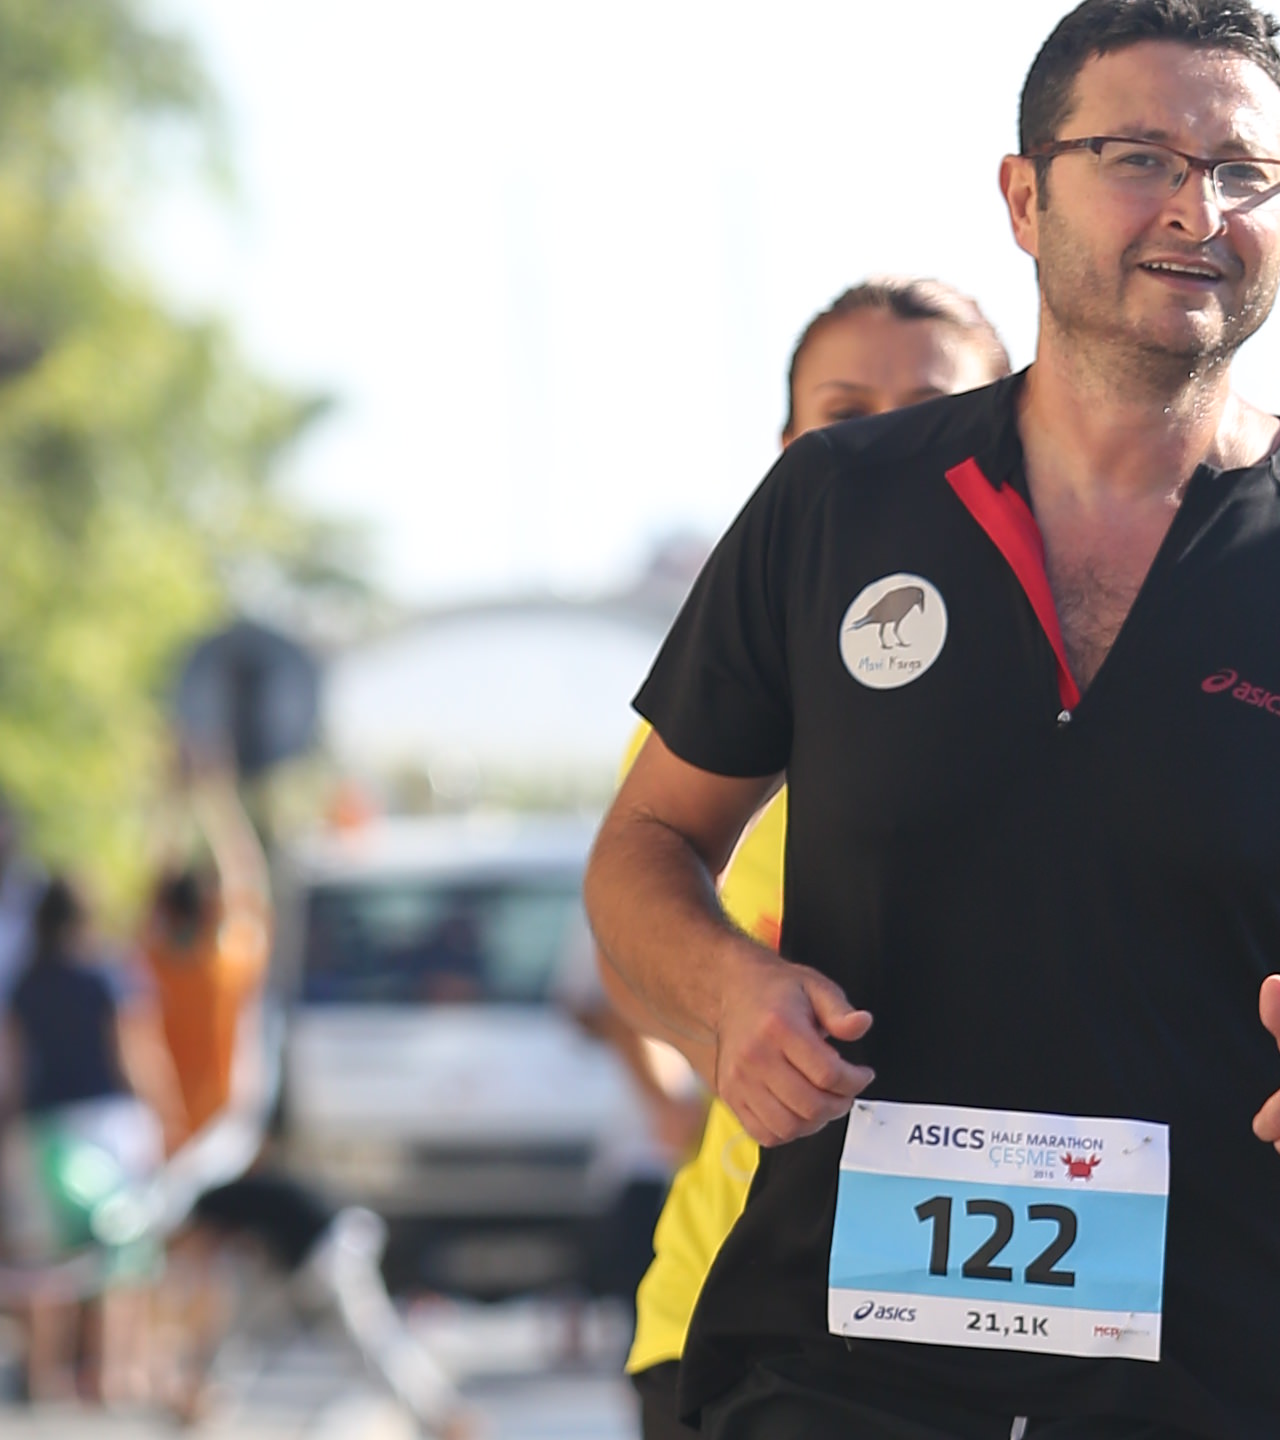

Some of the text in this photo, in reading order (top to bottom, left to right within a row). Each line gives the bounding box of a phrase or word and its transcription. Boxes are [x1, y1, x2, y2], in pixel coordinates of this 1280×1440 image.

[889, 656, 922, 673] Karga
[907, 1124, 1104, 1151] ASICS HALF MARATHON
[988, 1146, 1057, 1169] ÇEŞME
[913, 1195, 1079, 1288] 122
[874, 1305, 917, 1322] asics
[966, 1311, 1049, 1338] 21,1K
